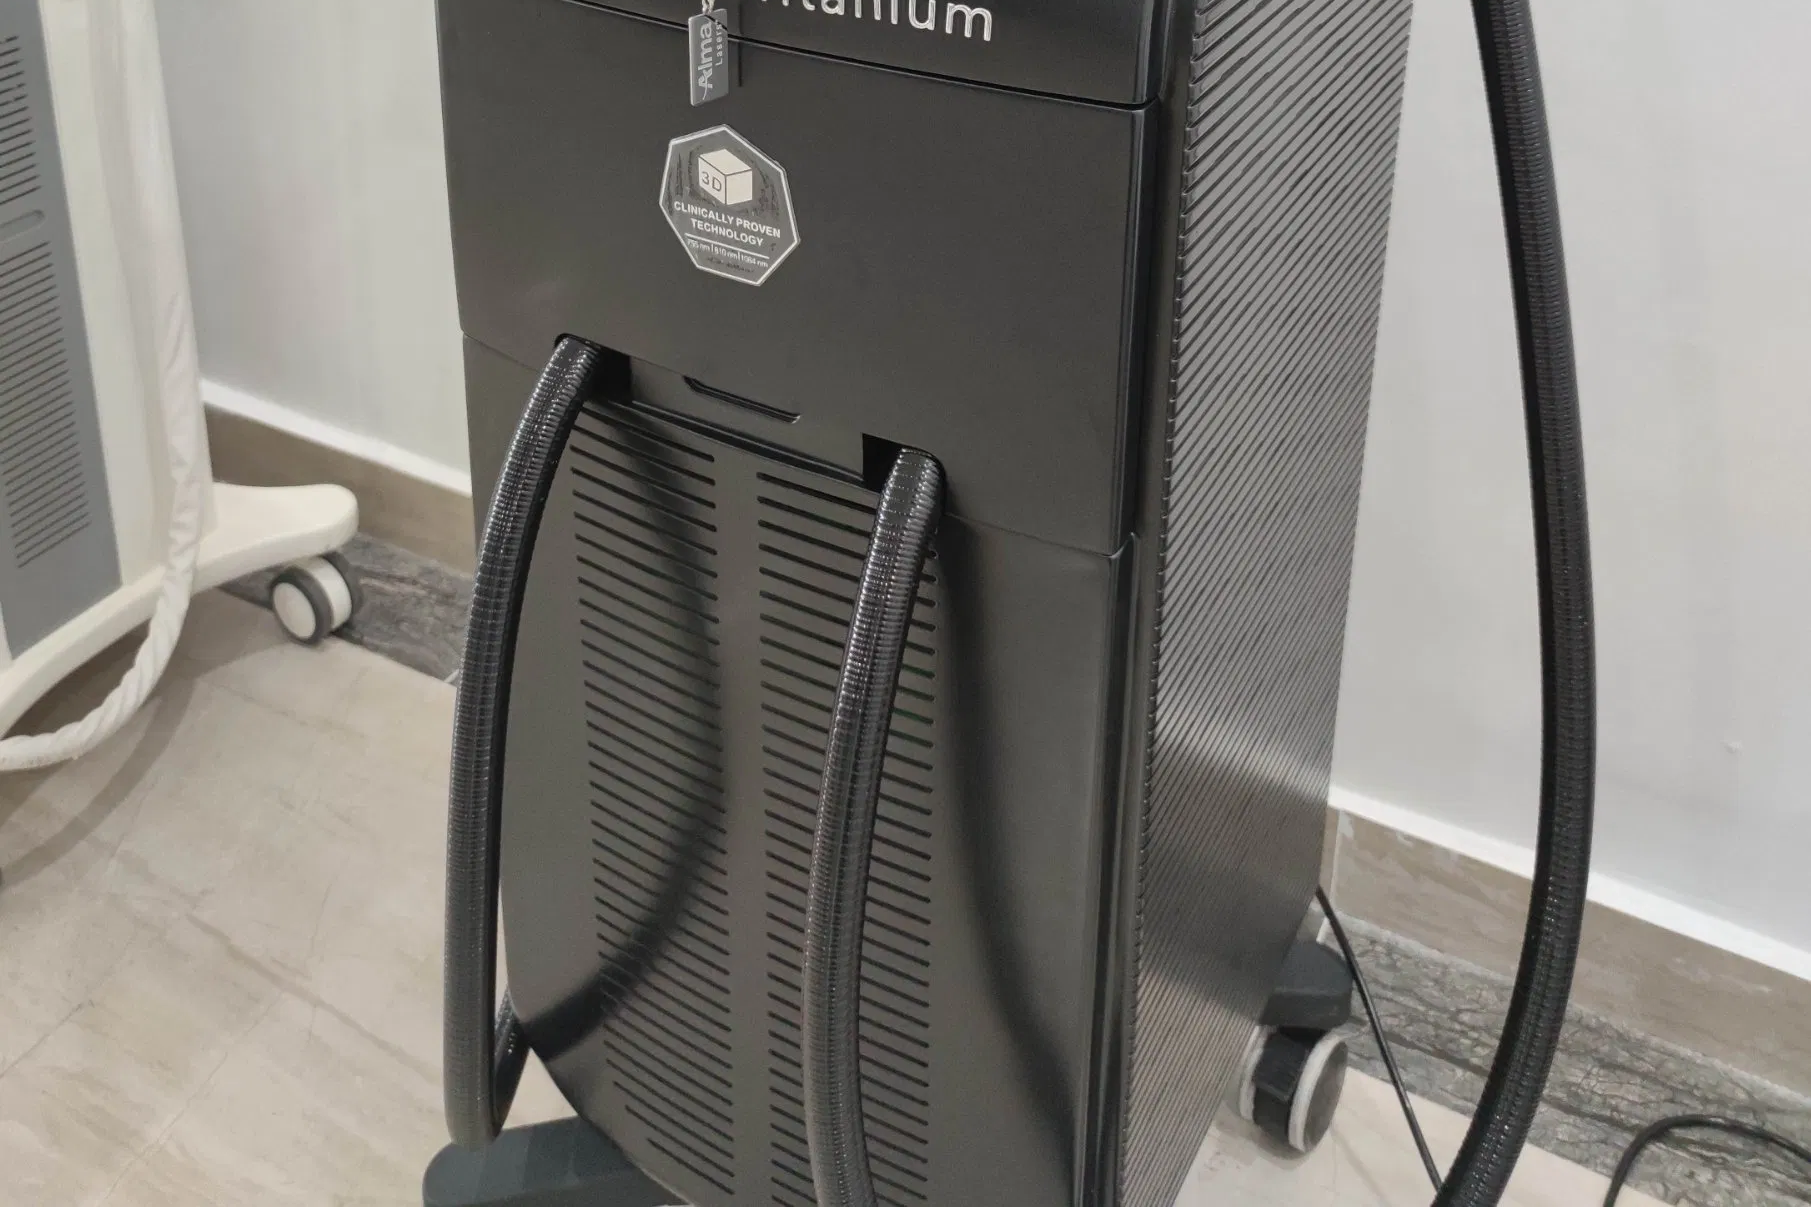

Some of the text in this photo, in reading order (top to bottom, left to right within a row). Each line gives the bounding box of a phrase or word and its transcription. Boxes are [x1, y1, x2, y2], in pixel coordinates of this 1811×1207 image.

[697, 21, 714, 102] Alma
[701, 171, 722, 192] 3D
[673, 201, 781, 238] CLINICALLY PROVEN
[690, 218, 764, 247] TECHNOLOGY
